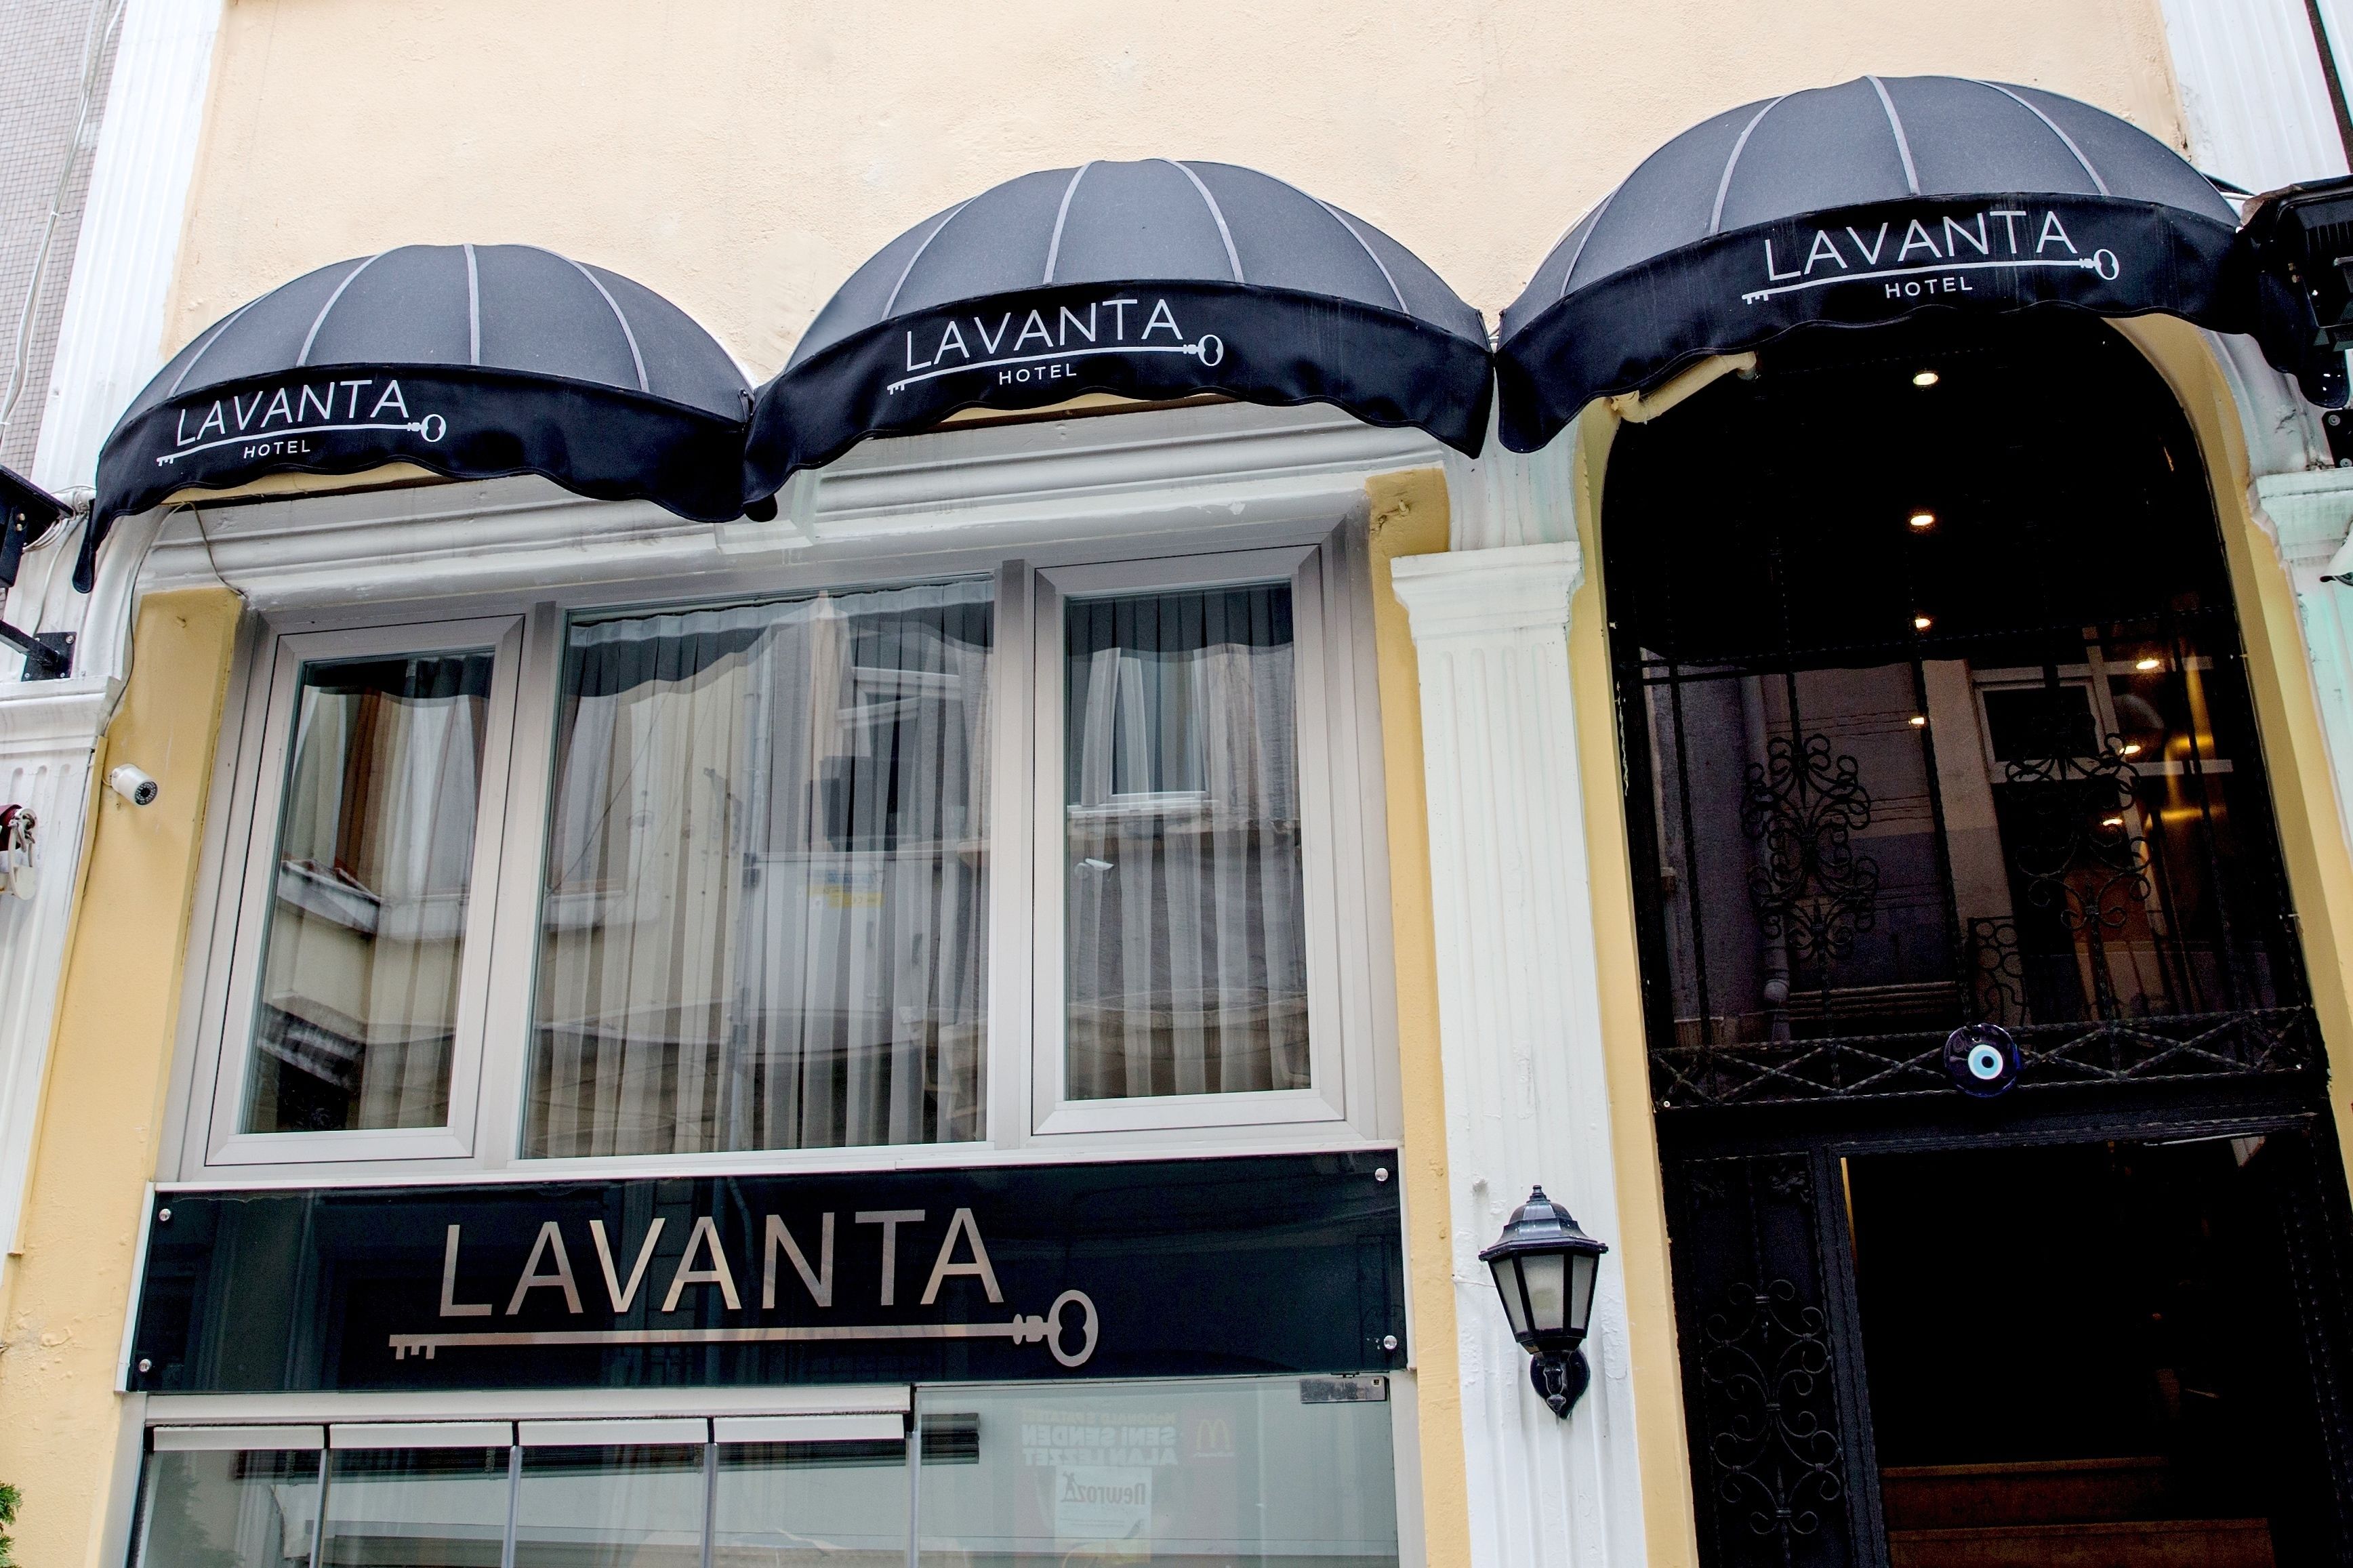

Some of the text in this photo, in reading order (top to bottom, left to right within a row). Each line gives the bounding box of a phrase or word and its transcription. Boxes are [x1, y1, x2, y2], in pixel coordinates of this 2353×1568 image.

[1764, 210, 2079, 281] LAVANTA
[1885, 276, 1973, 299] HOTEL
[906, 299, 1183, 373] LAVANTA
[999, 363, 1077, 386] HOTEL
[176, 379, 409, 447] LAVANTA
[243, 440, 311, 459] HOTEL
[440, 1208, 1004, 1317] LAVANTA
